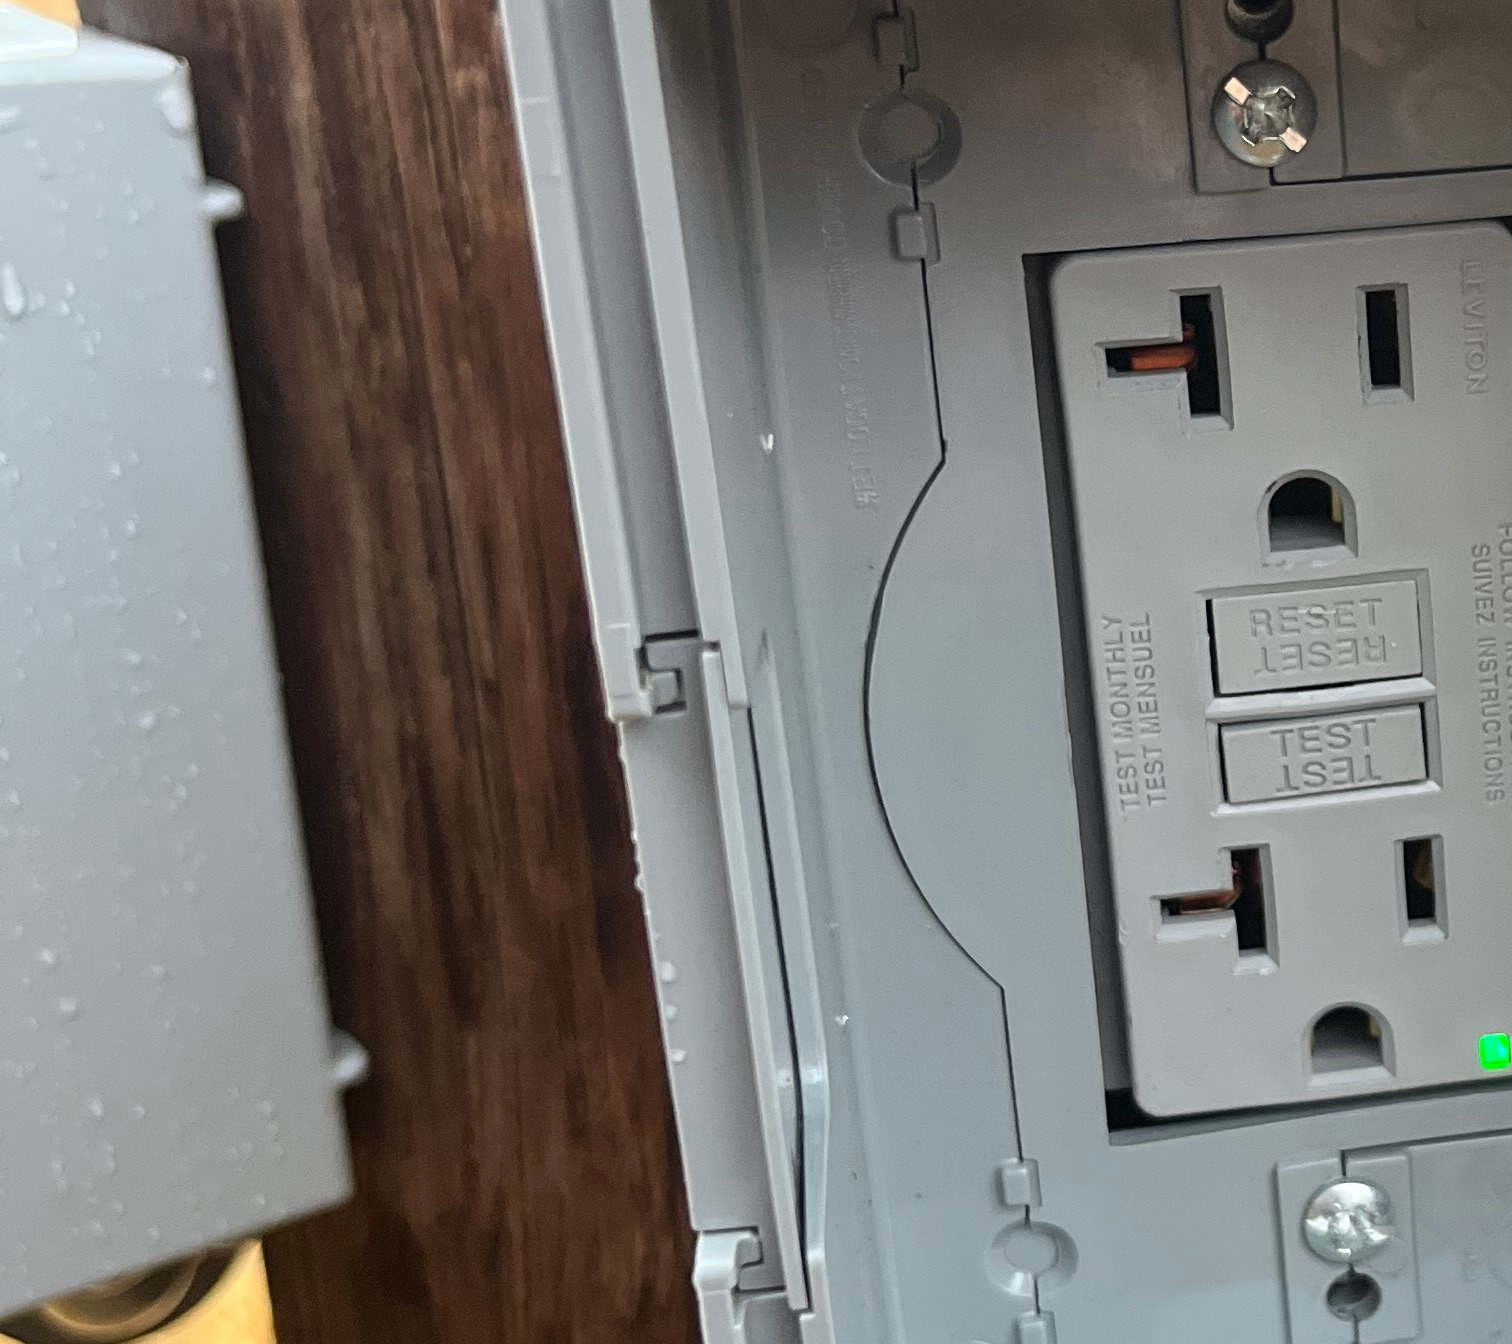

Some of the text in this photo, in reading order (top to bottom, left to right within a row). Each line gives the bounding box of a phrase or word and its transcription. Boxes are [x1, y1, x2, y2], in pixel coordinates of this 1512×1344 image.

[1461, 258, 1490, 394] LEVITON
[1250, 598, 1382, 638] RESET
[1254, 635, 1387, 674] RESET
[1102, 615, 1141, 813] TEST MONTHLY
[1131, 612, 1167, 806] TEST MENSUEL
[1471, 543, 1505, 804] SUIVEZ INSTRUCTIONS
[1270, 719, 1376, 757] TEST
[1276, 754, 1382, 793] TEST
